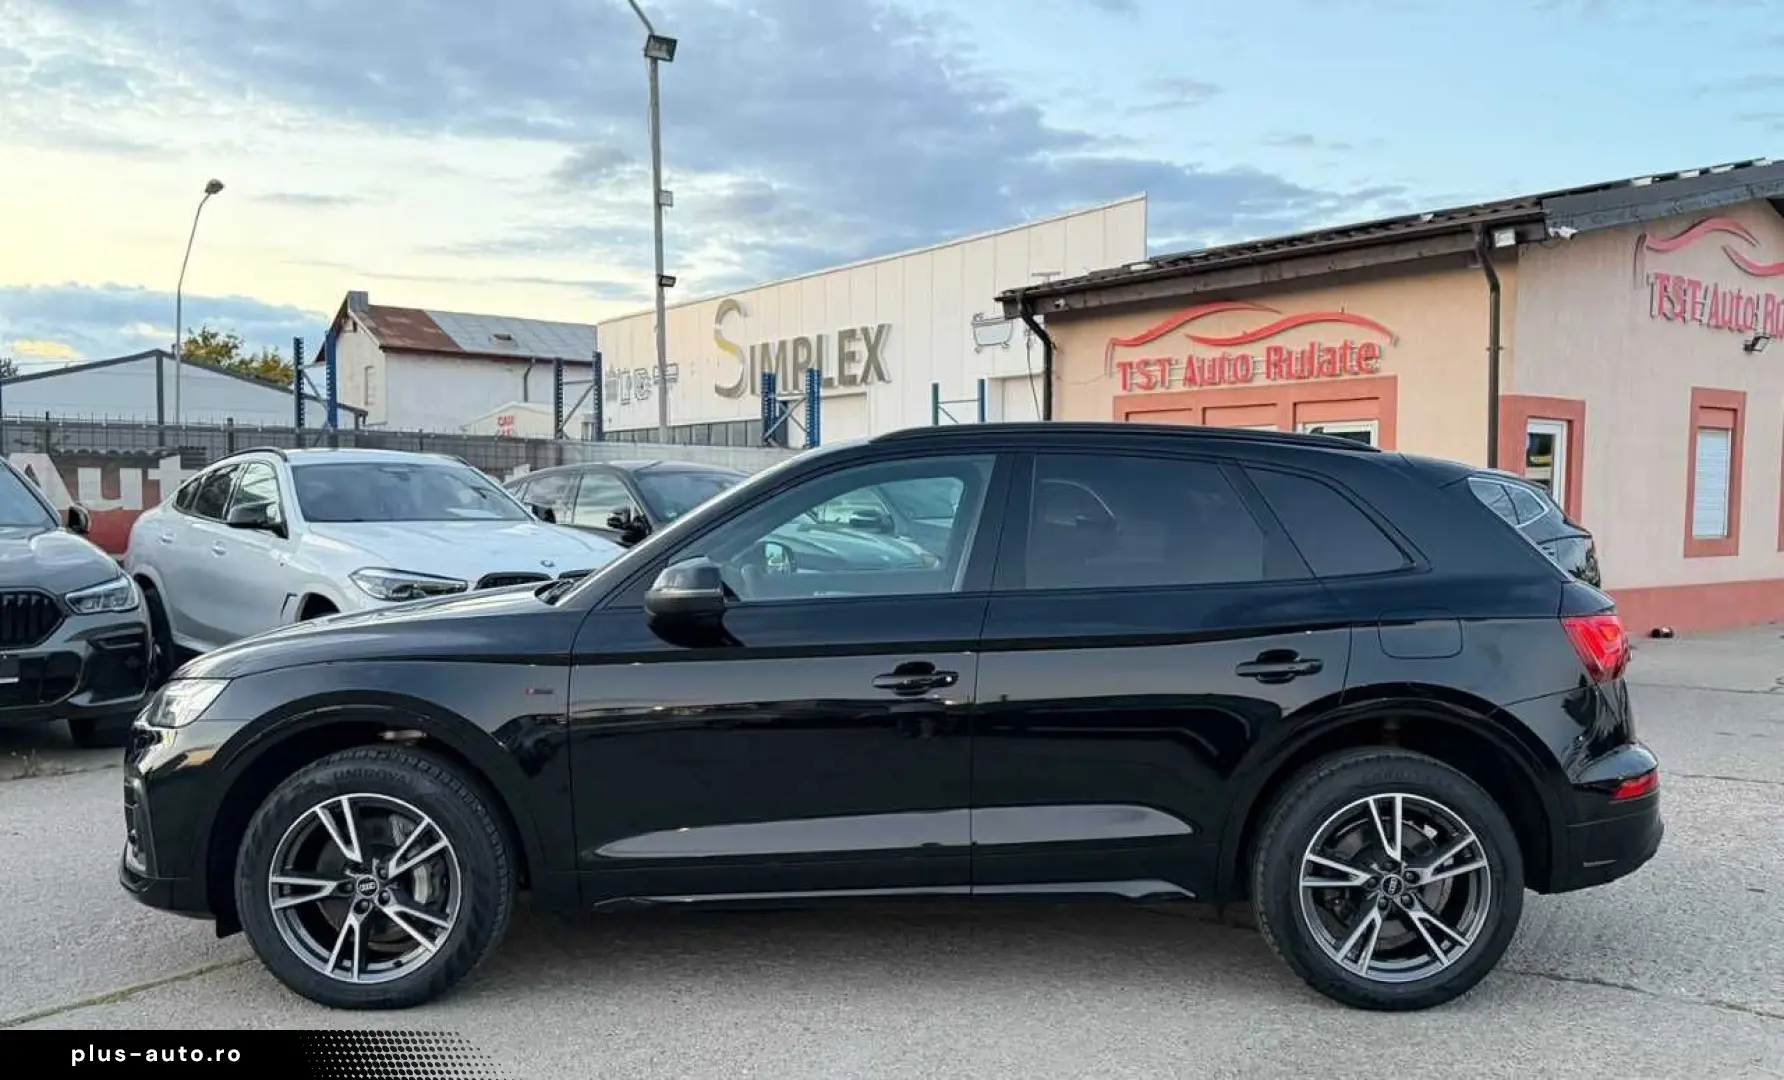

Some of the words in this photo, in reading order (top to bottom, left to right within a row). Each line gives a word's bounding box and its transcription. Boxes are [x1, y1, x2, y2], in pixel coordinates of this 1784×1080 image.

[1648, 272, 1702, 325] TST
[1707, 282, 1756, 332] Auto
[1117, 357, 1174, 392] TST
[1183, 352, 1253, 387] Auto
[1265, 339, 1381, 380] Rulate
